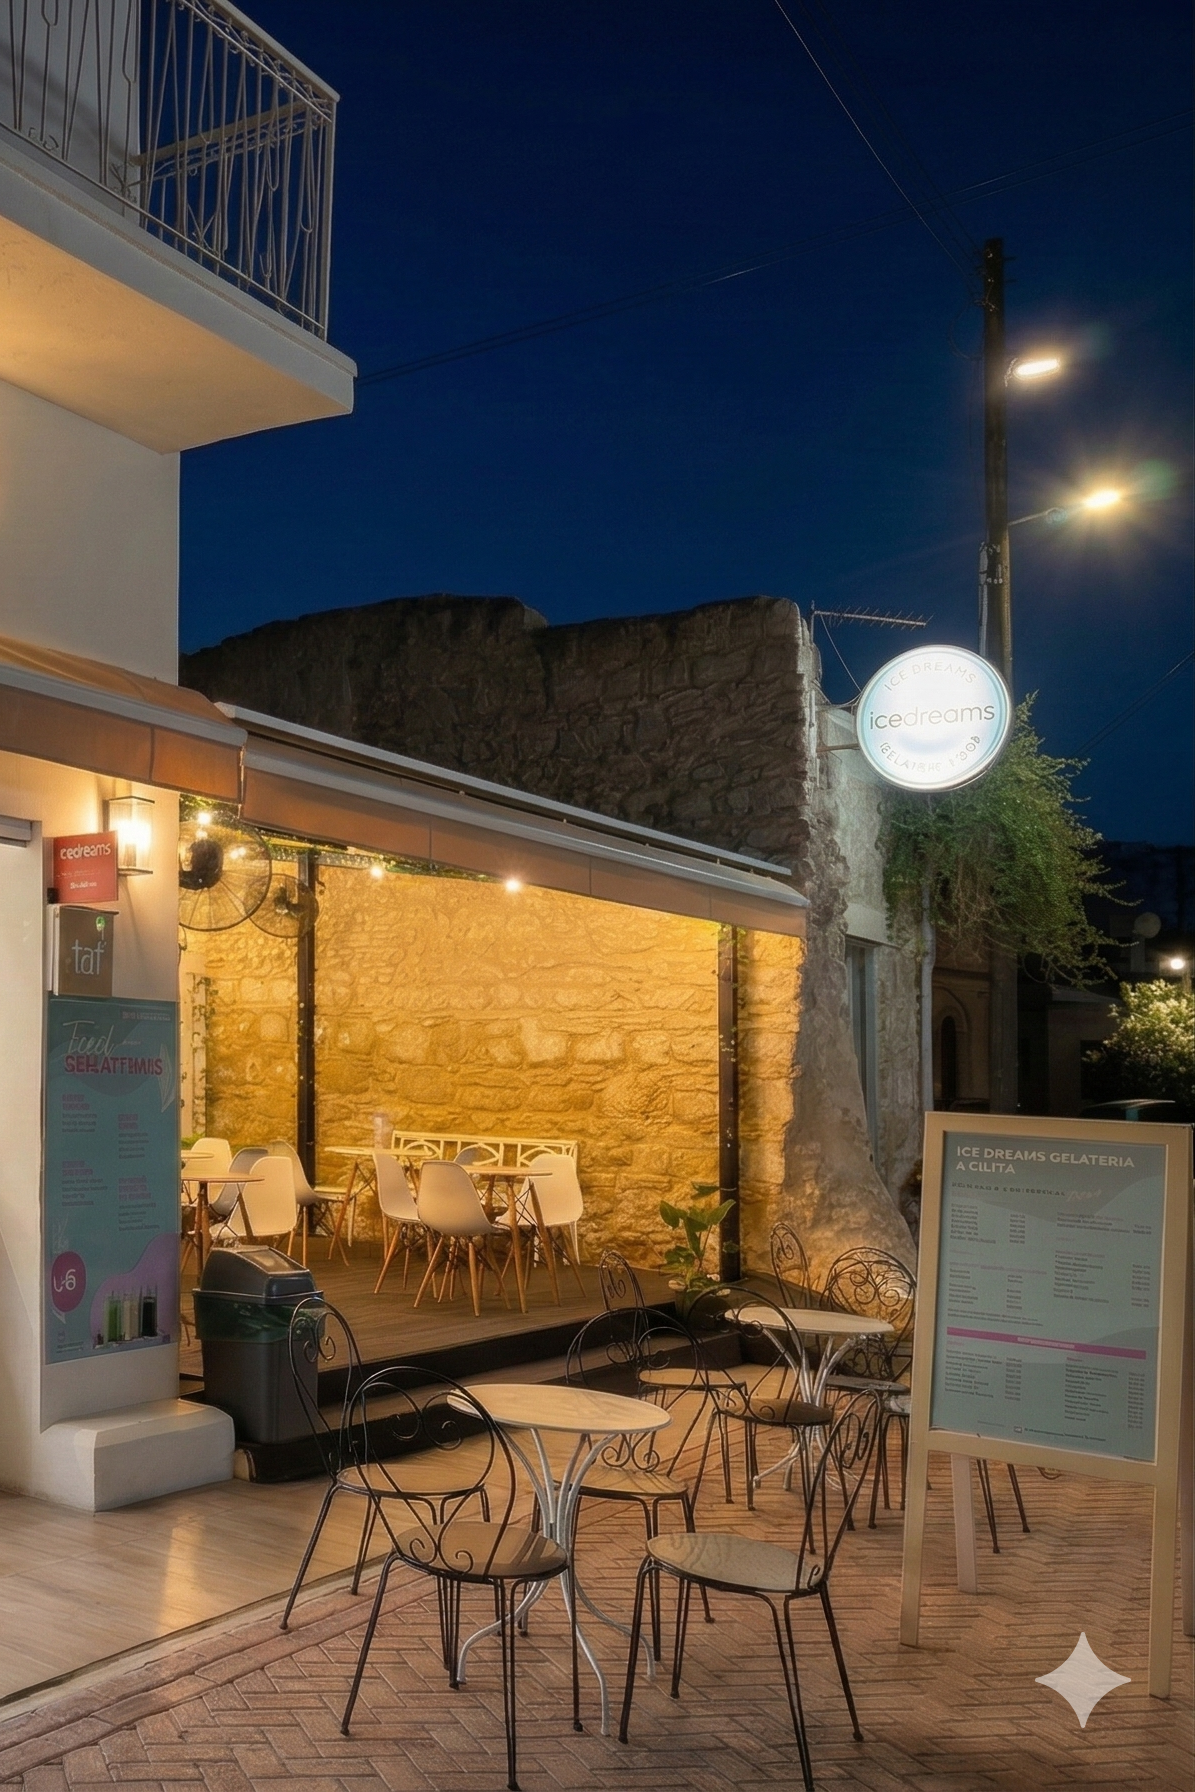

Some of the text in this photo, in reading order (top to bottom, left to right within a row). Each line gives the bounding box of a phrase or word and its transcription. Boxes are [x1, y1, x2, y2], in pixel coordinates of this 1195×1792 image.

[884, 661, 977, 691] ICE DREAMS
[870, 705, 995, 729] icedreams
[956, 1145, 1136, 1168] ICE DREAMS GELATERIA
